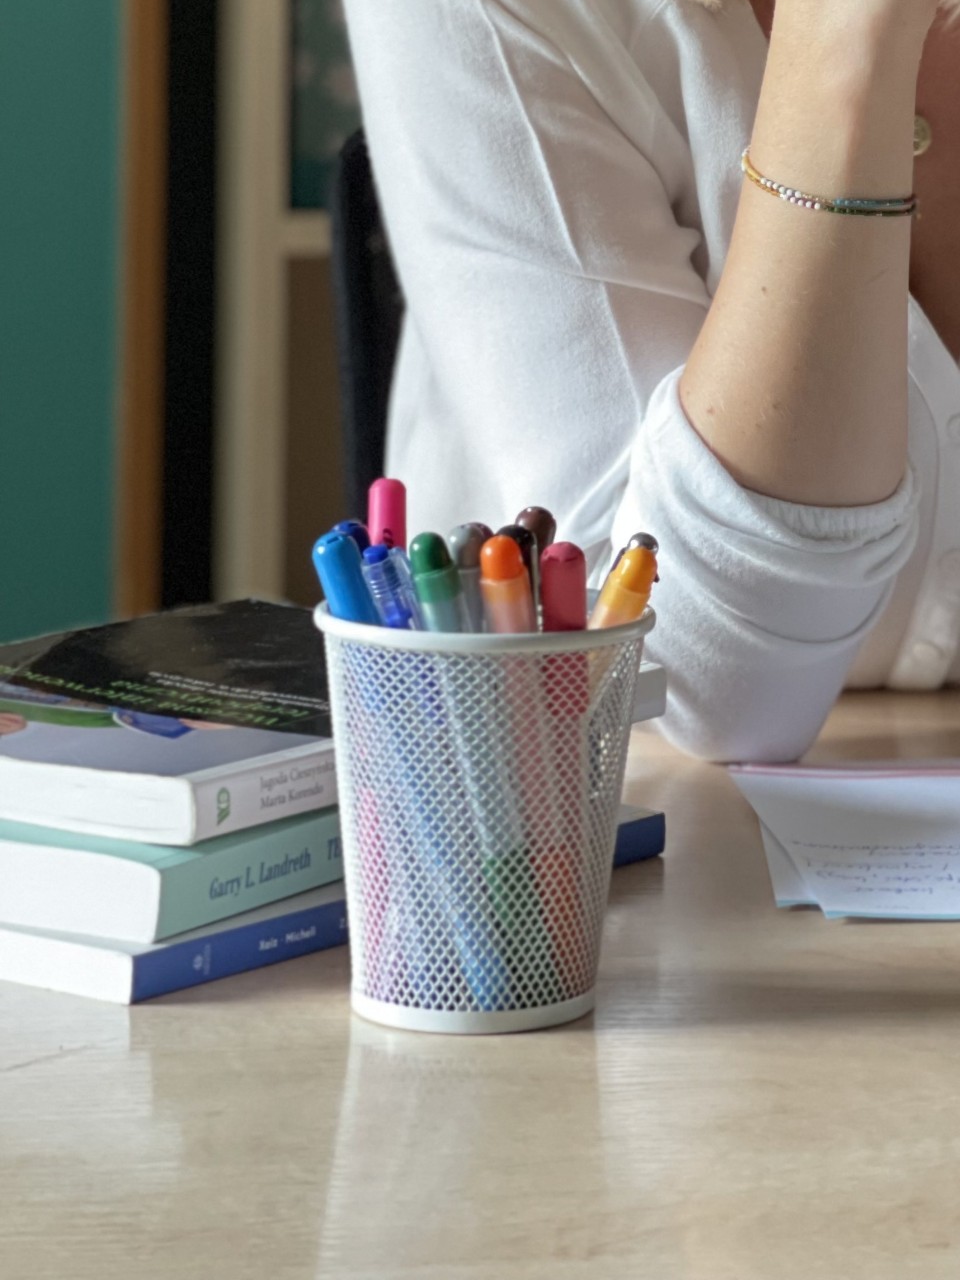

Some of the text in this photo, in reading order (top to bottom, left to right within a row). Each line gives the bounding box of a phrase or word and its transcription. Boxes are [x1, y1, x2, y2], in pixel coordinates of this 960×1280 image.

[209, 847, 311, 900] Garry L. Landreth
